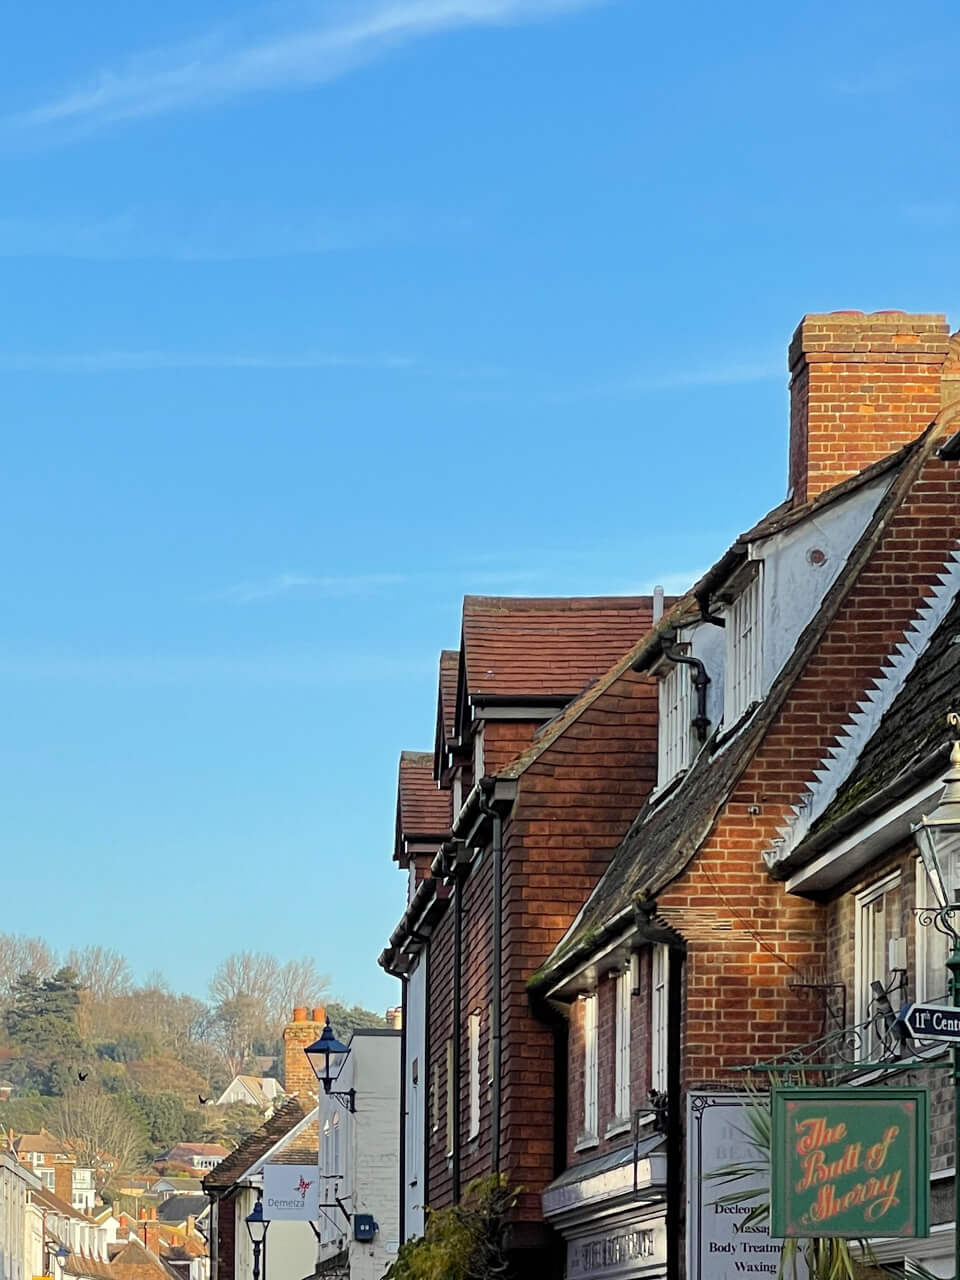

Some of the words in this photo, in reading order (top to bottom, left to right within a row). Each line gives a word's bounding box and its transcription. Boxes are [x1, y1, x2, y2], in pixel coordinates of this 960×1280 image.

[932, 1012, 960, 1031] Cent
[795, 1117, 847, 1154] The
[795, 1150, 862, 1194] Butt
[864, 1125, 900, 1173] of
[267, 1198, 305, 1209] Demelza
[800, 1169, 901, 1224] Sherry
[733, 1223, 770, 1236] Massa
[710, 1242, 736, 1255] Body
[741, 1242, 802, 1253] Treatms
[735, 1262, 777, 1274] Waxing
